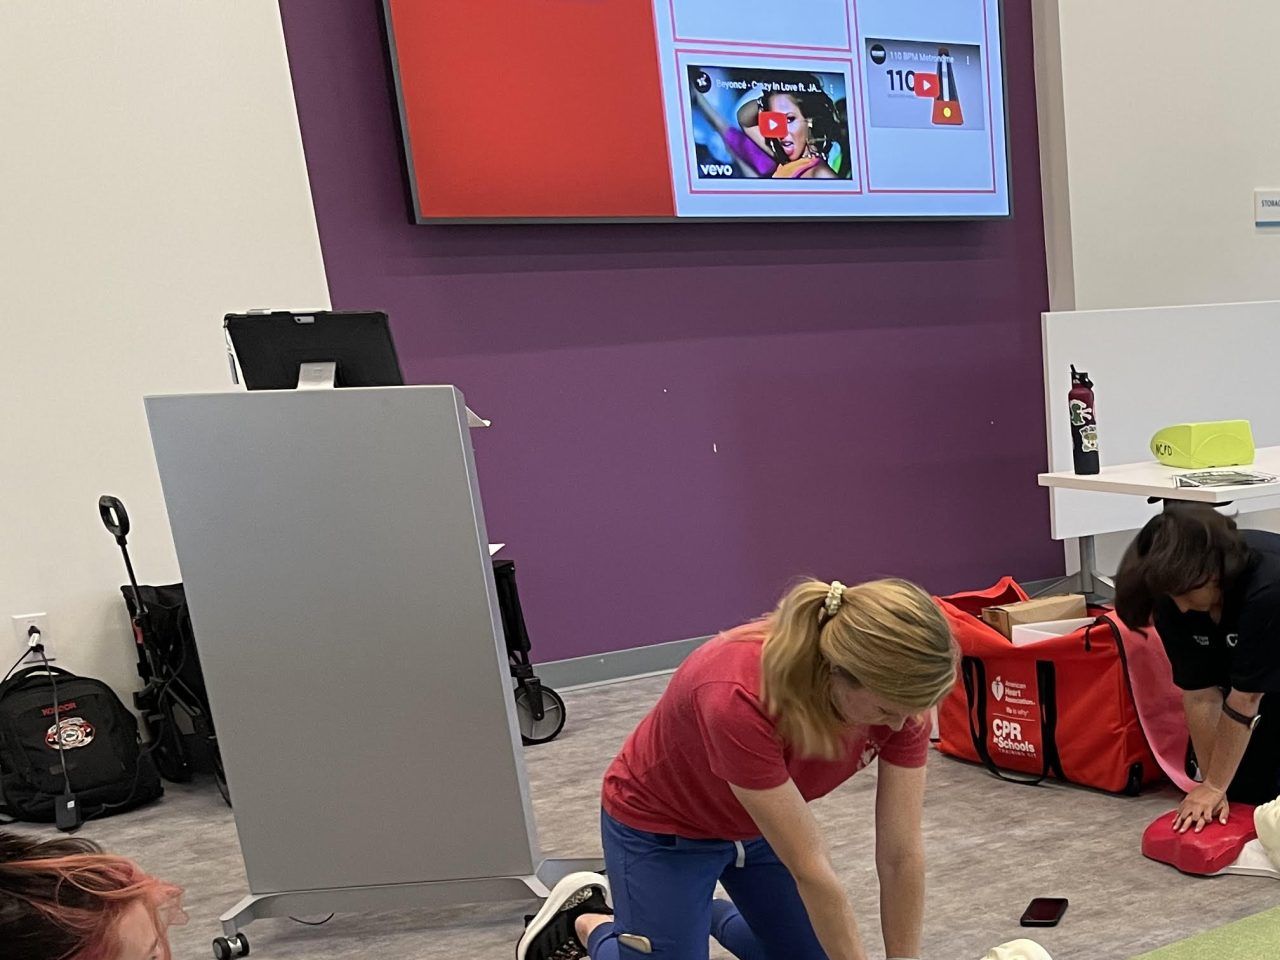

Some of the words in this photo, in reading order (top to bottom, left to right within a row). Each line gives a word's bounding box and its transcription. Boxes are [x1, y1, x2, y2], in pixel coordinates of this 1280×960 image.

[751, 80, 771, 92] Cazy
[780, 82, 798, 92] Love
[992, 718, 1021, 740] CPR
[998, 736, 1036, 753] Schools
